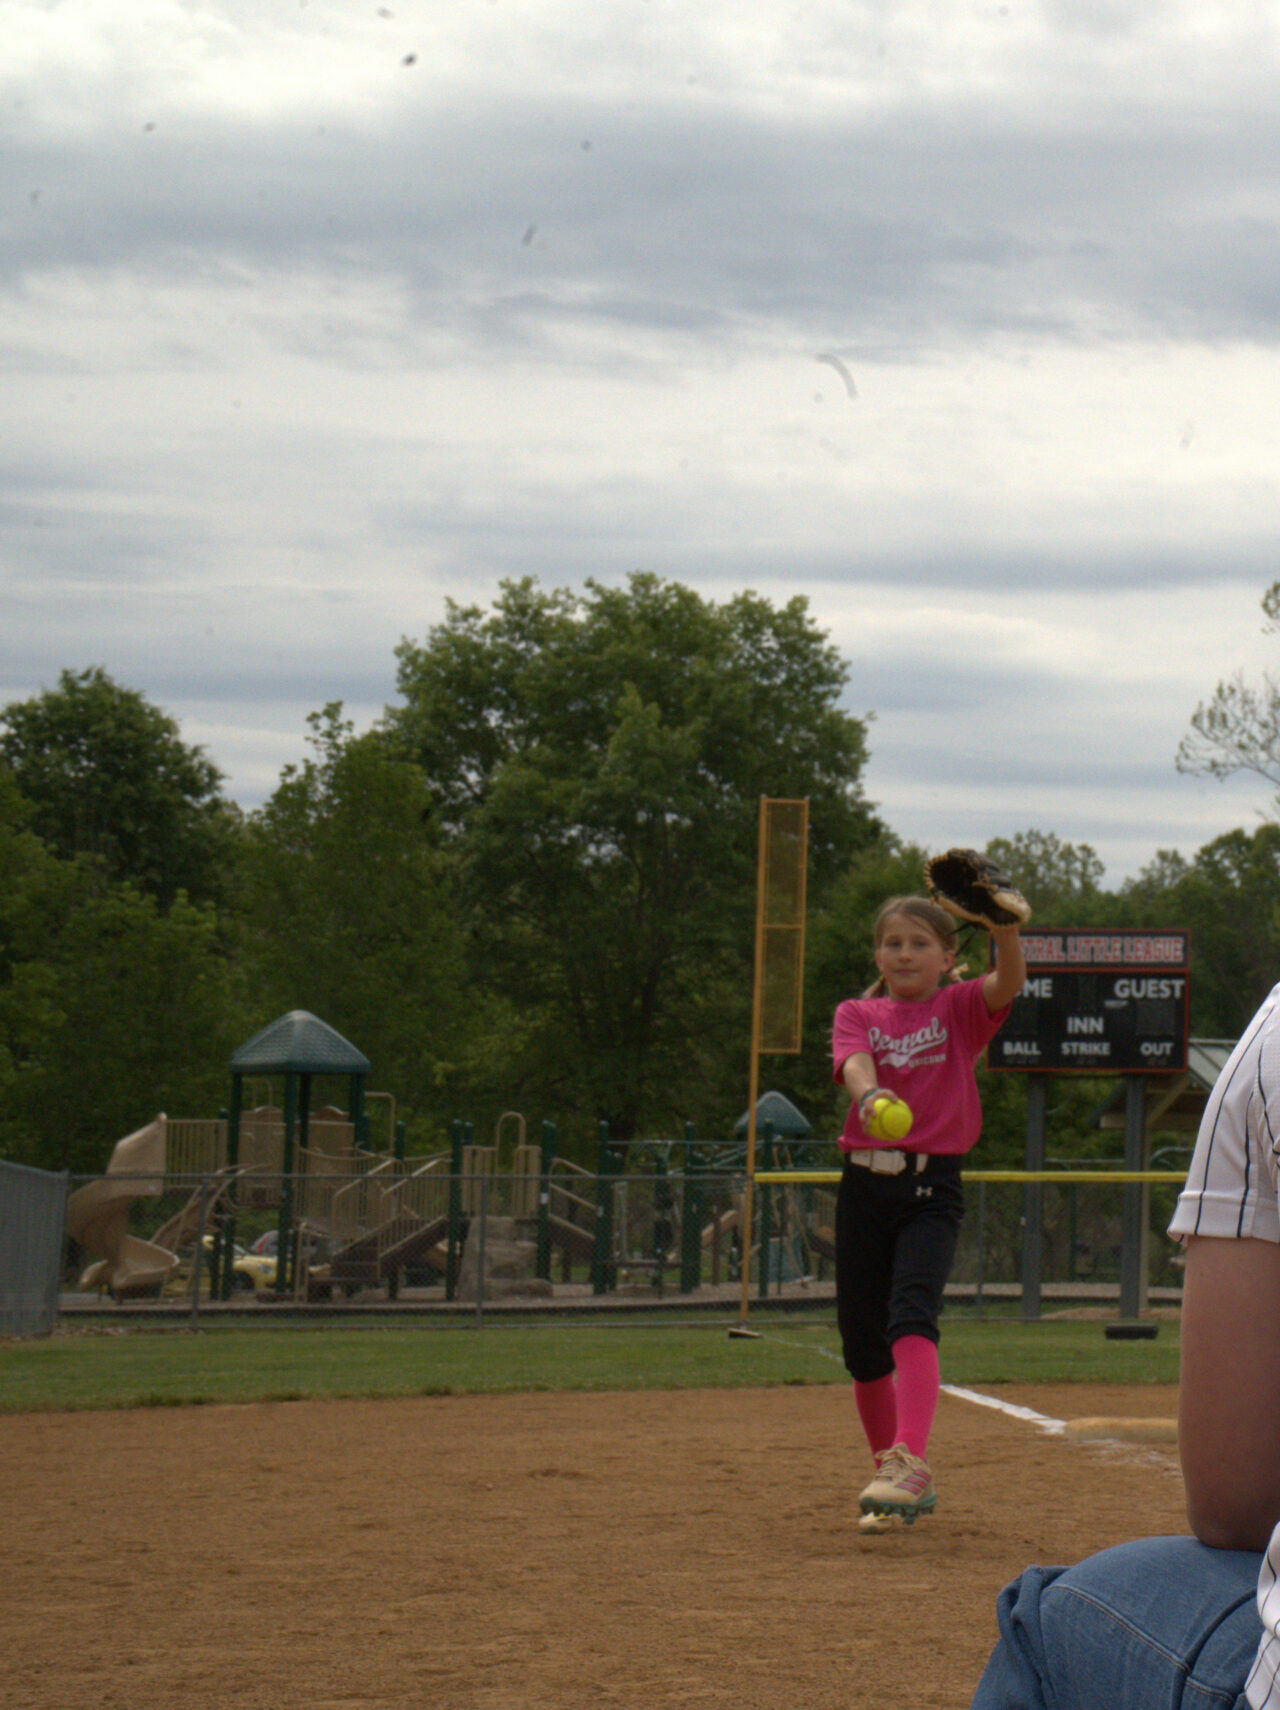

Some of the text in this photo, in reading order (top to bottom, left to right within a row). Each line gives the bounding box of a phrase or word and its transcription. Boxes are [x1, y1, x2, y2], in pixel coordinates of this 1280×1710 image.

[1020, 936, 1185, 963] TRAL LITTLE LEAGUE
[1018, 978, 1053, 998] ME
[1114, 978, 1185, 999] GUEST
[1067, 1016, 1104, 1034] INN
[1003, 1041, 1041, 1056] BALL
[1061, 1041, 1110, 1056] STRIKE
[1140, 1042, 1174, 1056] OUT
